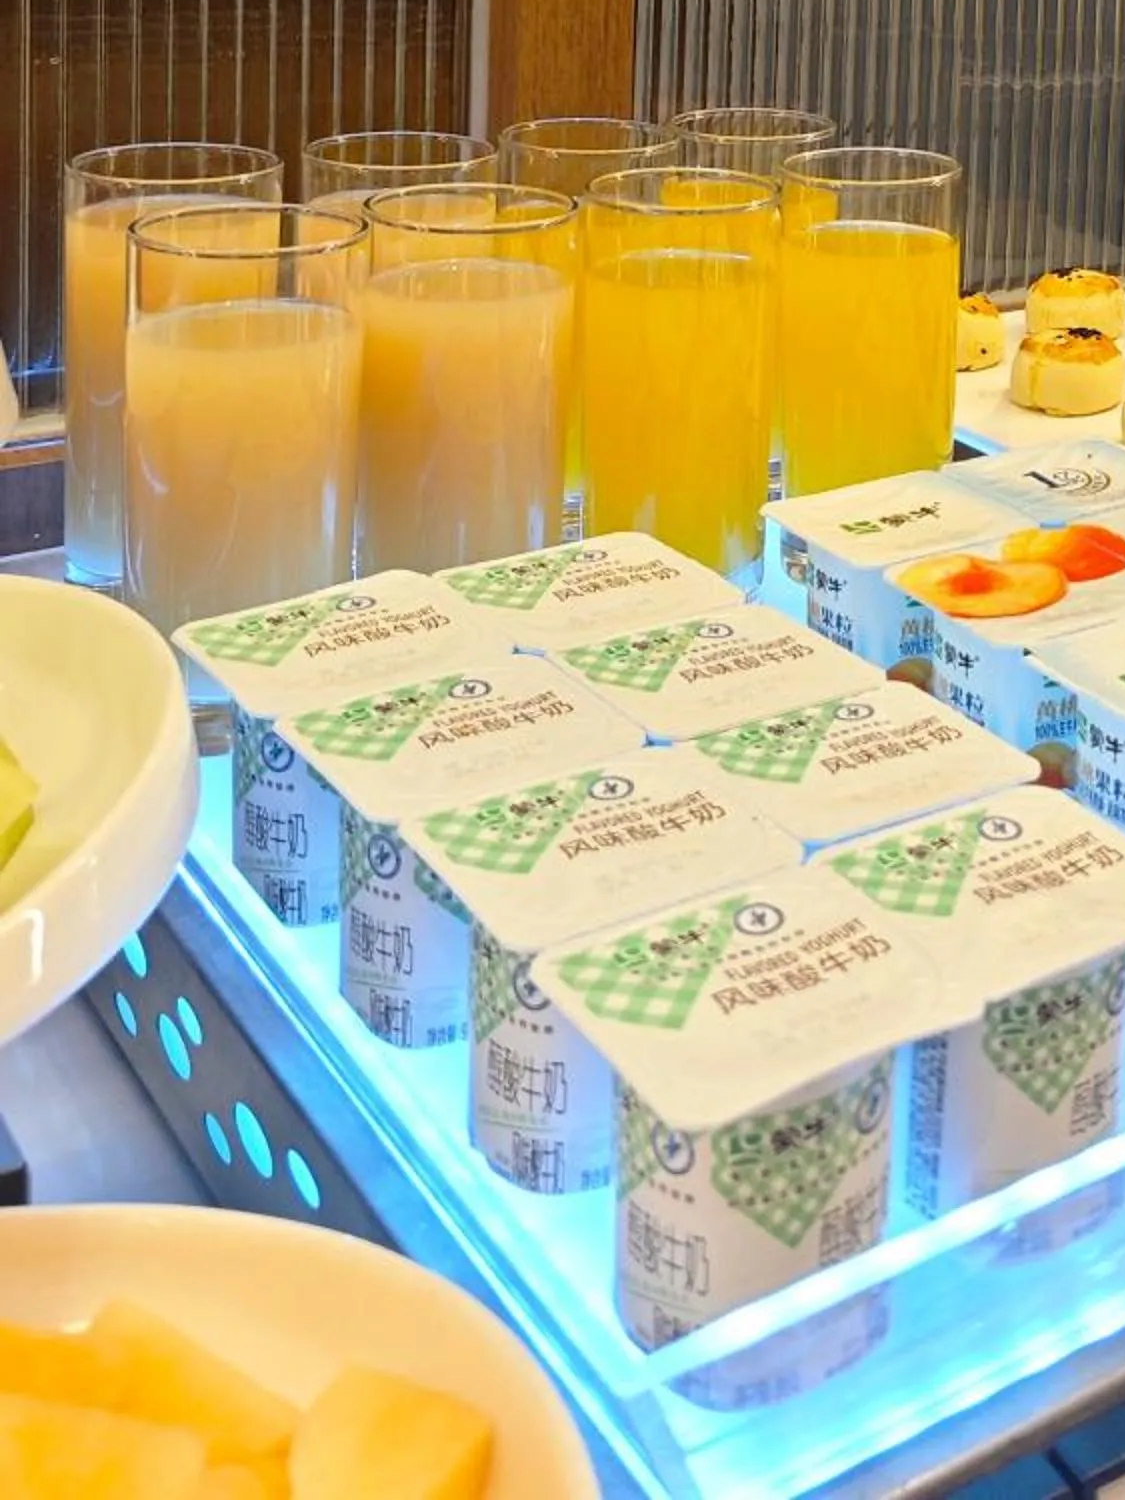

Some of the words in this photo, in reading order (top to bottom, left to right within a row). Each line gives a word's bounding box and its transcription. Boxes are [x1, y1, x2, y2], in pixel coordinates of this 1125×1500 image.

[304, 614, 451, 658] 风味酸牛奶
[418, 699, 575, 750] 风味酸牛奶
[820, 724, 964, 776] 风味酸牛奶
[559, 800, 727, 861] 风味酸牛奶
[972, 844, 1125, 906] 风味酸牛奶
[711, 933, 892, 1016] 风味酸牛奶
